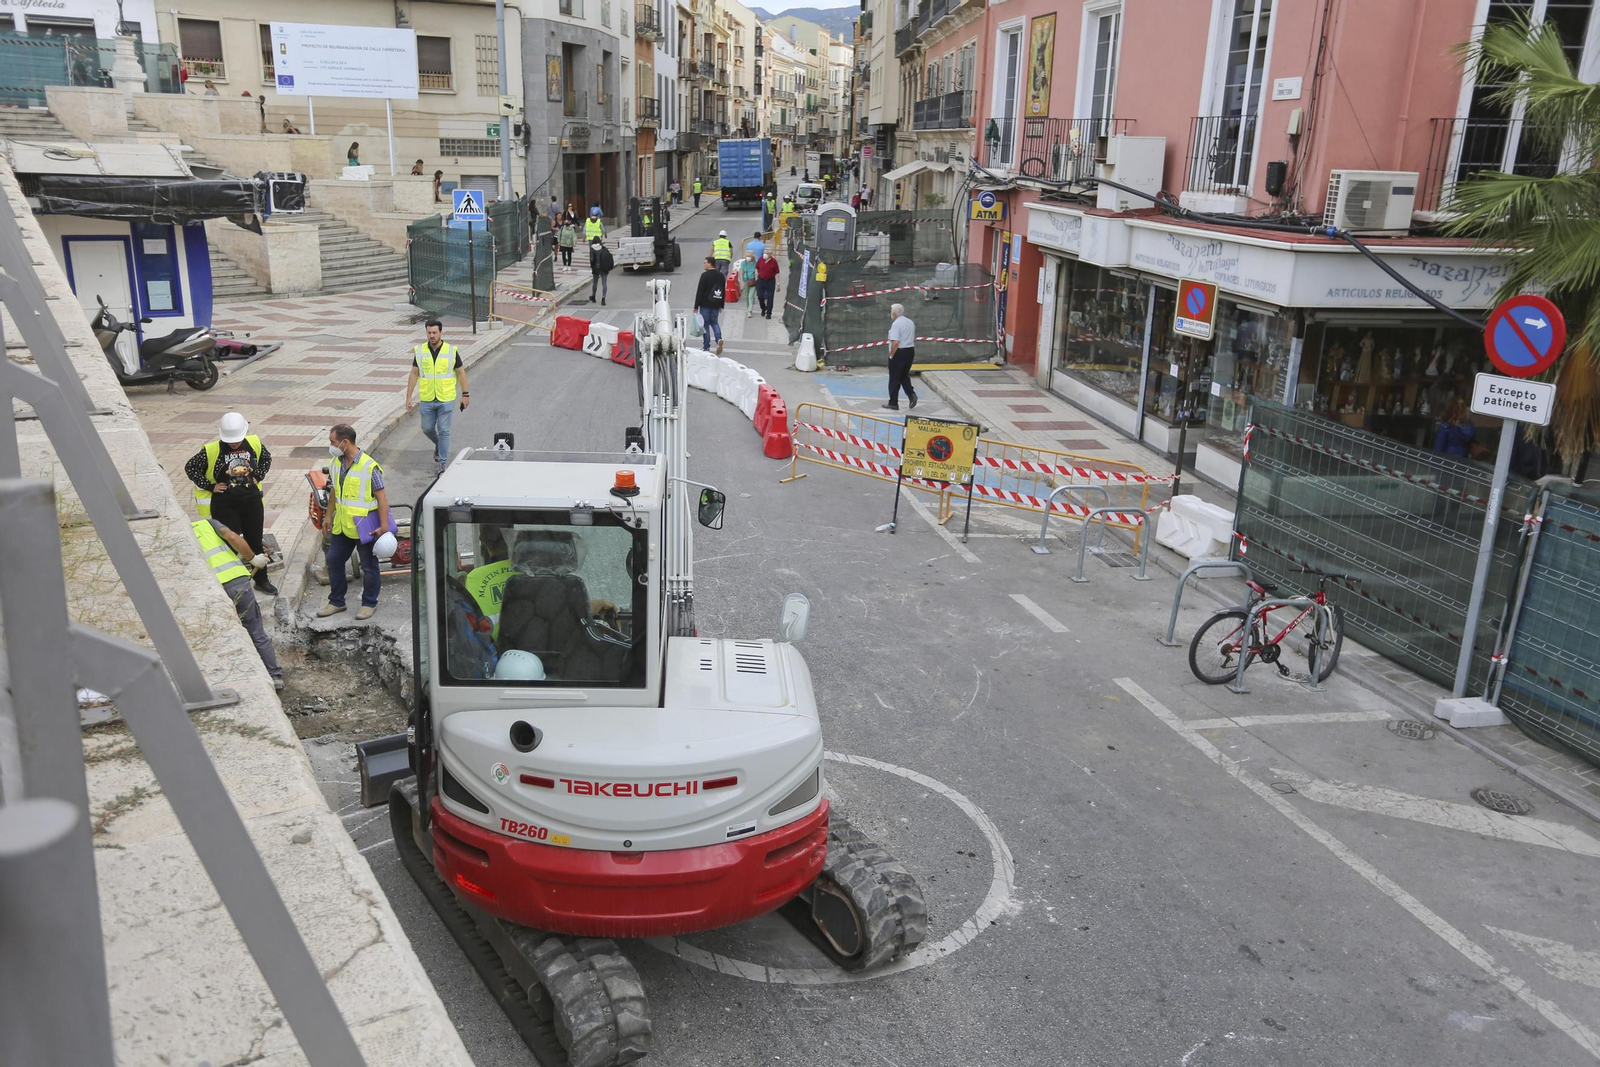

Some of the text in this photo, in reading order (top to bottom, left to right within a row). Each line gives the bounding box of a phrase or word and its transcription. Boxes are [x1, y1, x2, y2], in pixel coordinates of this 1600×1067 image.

[976, 211, 998, 219] ATM
[1326, 288, 1382, 299] ARTICULOS
[1489, 384, 1537, 400] Excepto
[1483, 396, 1538, 412] patinetes
[904, 458, 926, 467] PROHIBIDO
[478, 570, 500, 598] MARTIN
[560, 778, 698, 798] TAKEUCHI
[500, 817, 549, 841] TB260
